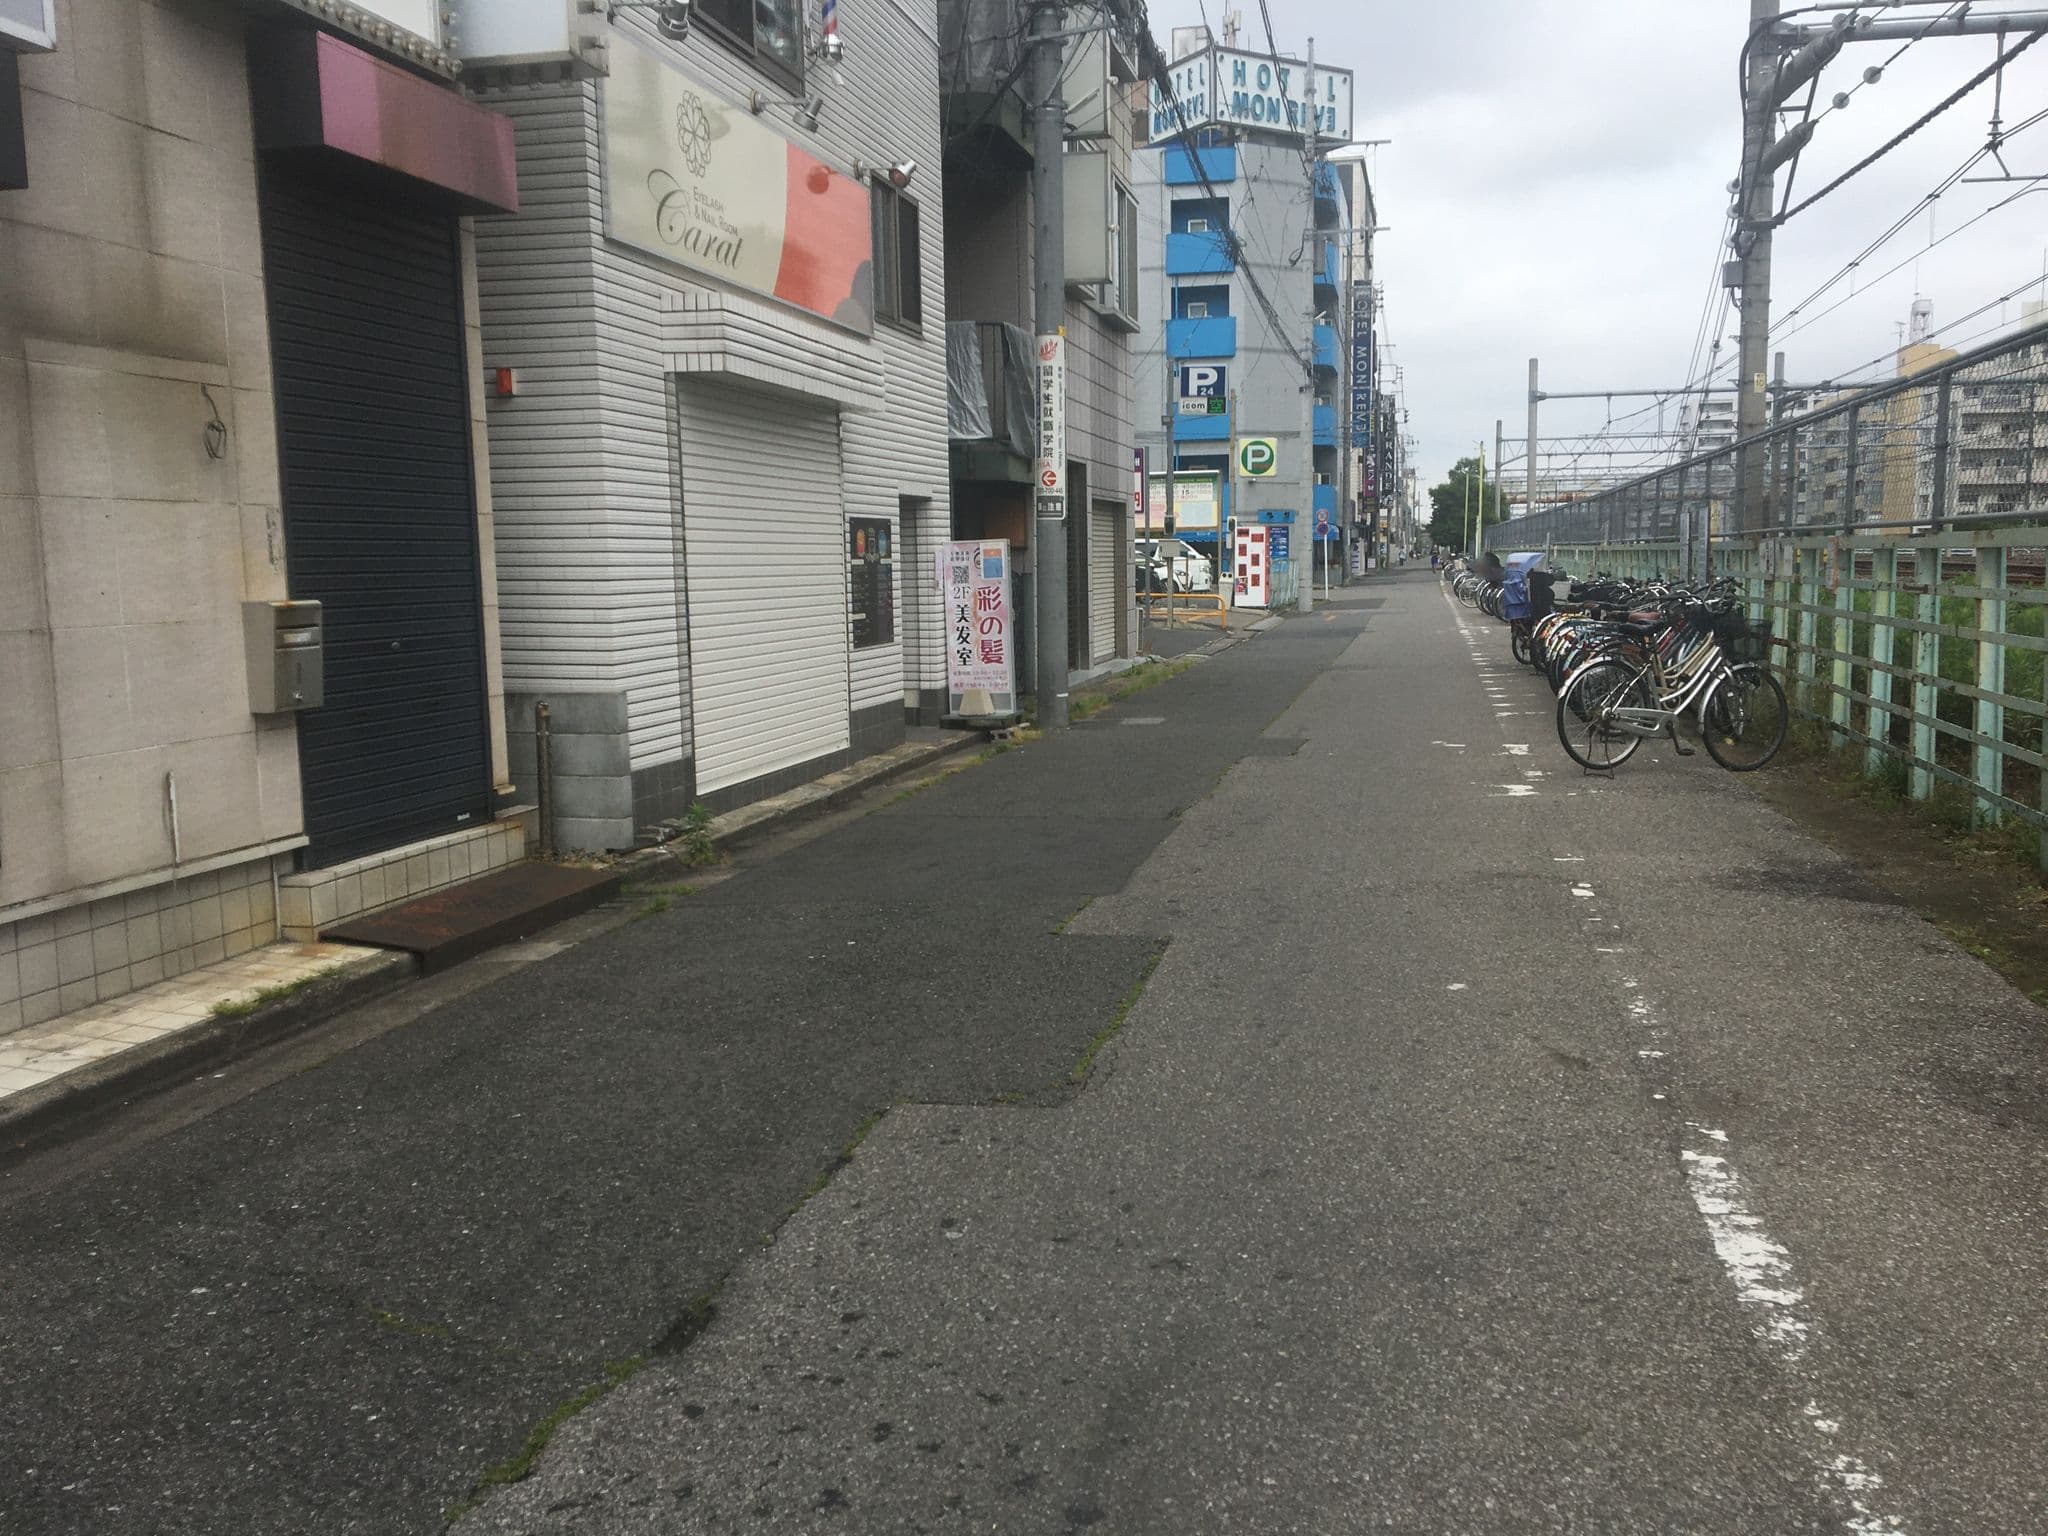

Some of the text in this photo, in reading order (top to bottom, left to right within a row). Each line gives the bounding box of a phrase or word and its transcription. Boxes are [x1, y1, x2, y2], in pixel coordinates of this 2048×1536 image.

[1233, 59, 1335, 102] HOTL
[1232, 91, 1280, 124] MON
[648, 169, 742, 269] Carat
[1189, 367, 1218, 396] P
[1200, 387, 1214, 396] 24
[1182, 402, 1206, 410] icom
[1246, 445, 1271, 471] P
[953, 586, 971, 599] 2F
[955, 604, 973, 666] 美发室
[977, 586, 1004, 665] 彩の髪
